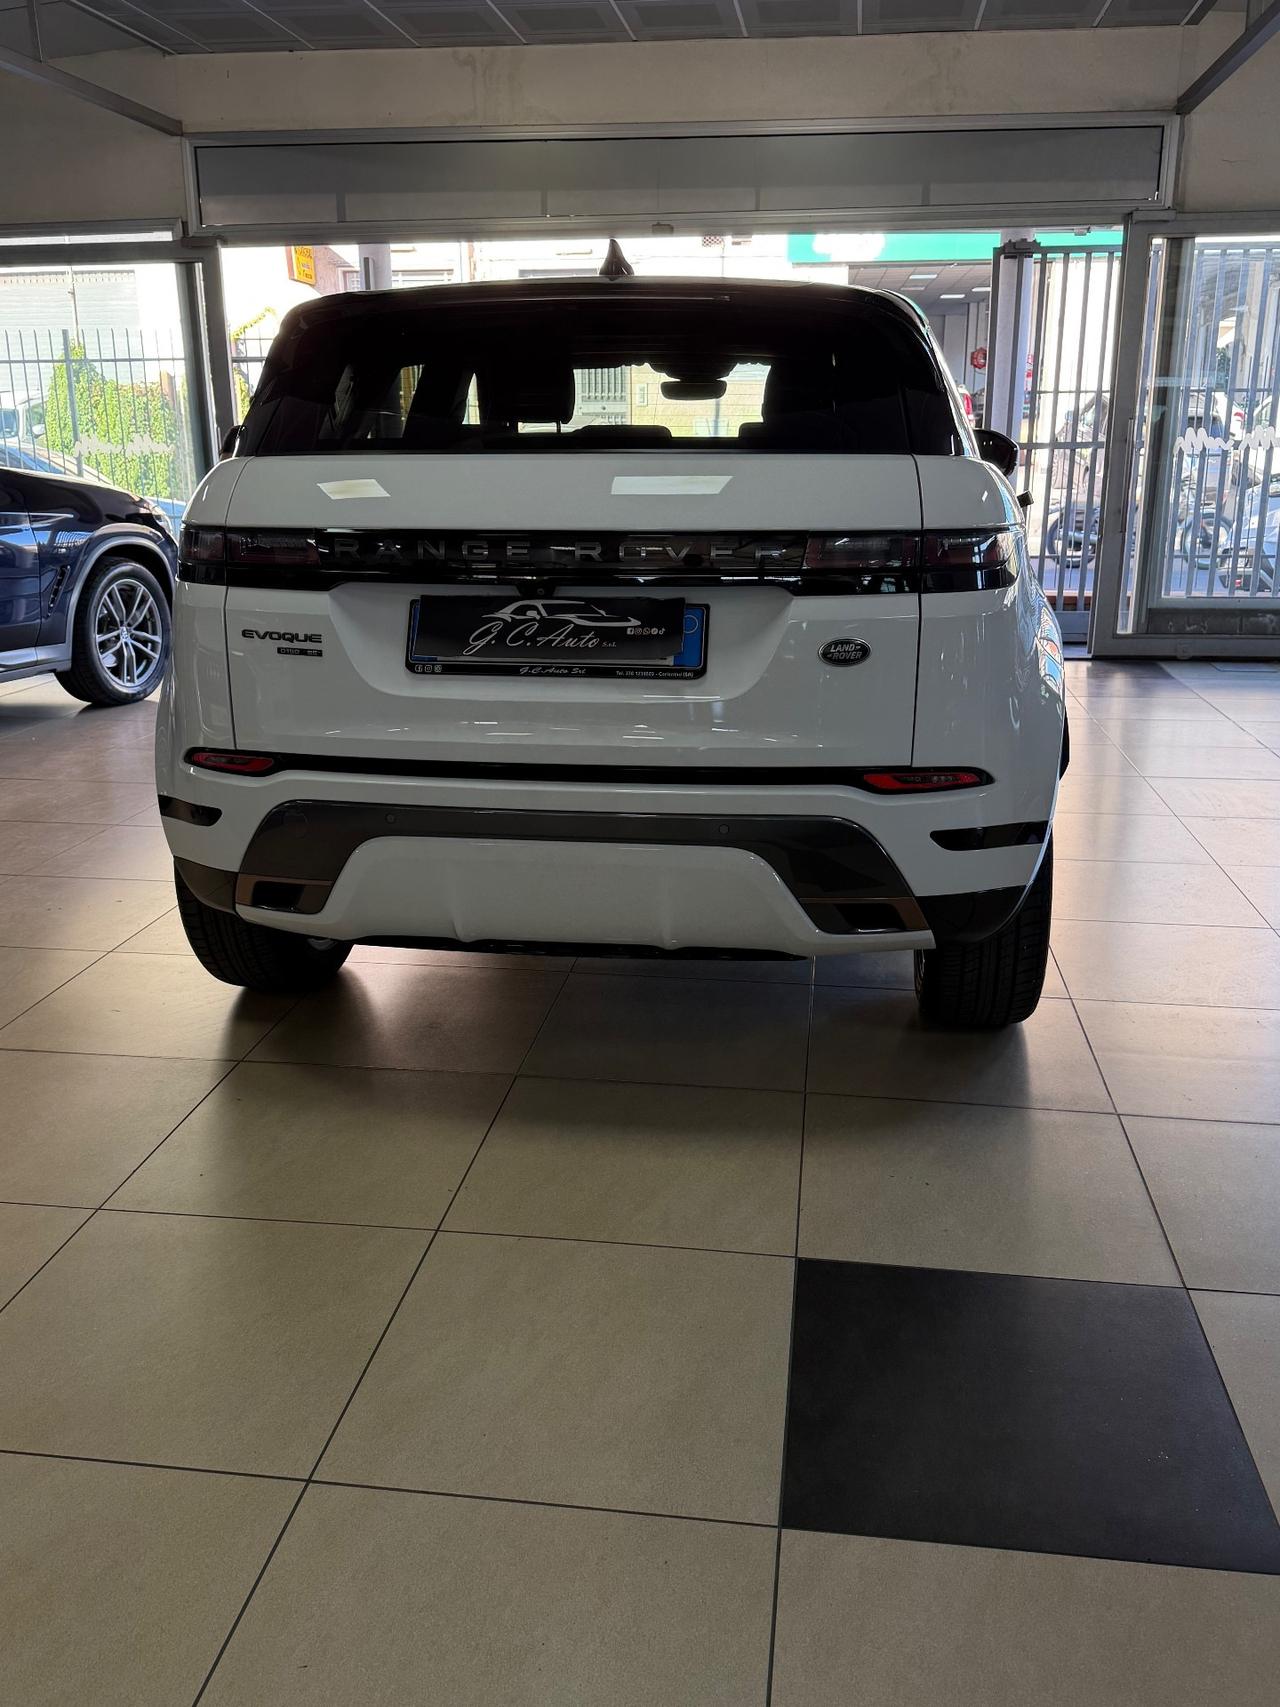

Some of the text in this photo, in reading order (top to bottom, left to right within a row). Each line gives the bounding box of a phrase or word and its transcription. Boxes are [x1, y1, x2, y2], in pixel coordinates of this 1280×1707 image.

[334, 537, 531, 561] RANGE
[241, 629, 322, 643] EVOQUE
[830, 643, 863, 660] LAND ROVER
